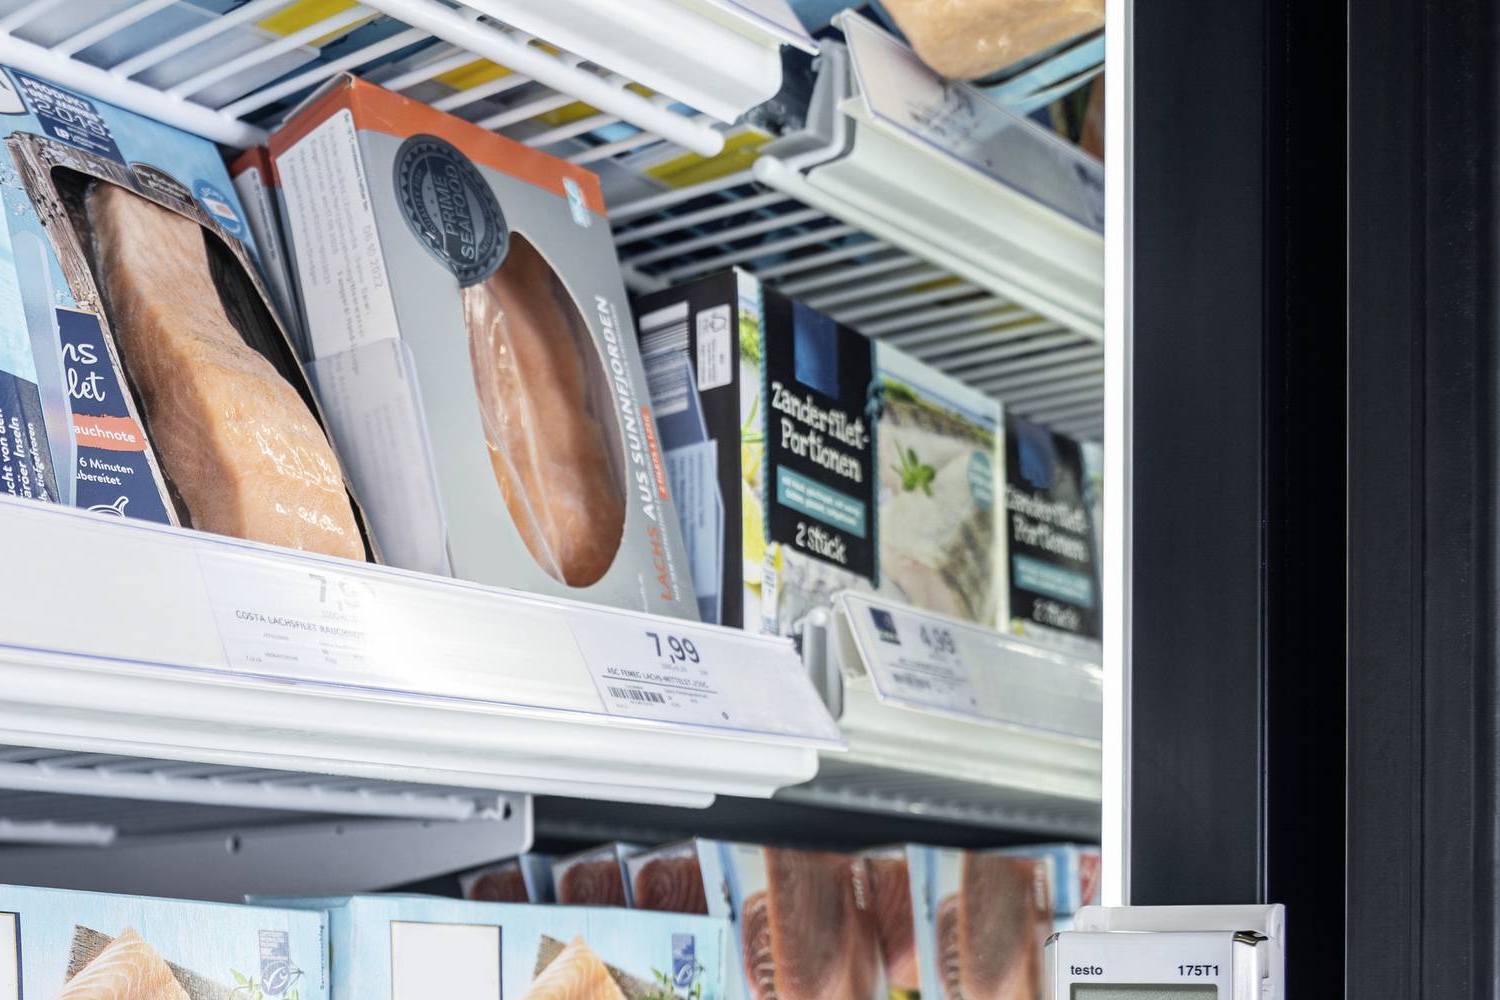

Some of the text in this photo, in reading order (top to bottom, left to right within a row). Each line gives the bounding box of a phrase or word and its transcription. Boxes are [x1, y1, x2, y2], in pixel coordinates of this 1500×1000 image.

[435, 174, 460, 236] PRIME
[446, 164, 475, 261] SEAFOOD
[68, 367, 106, 402] let
[593, 294, 648, 468] SUNNFJORDEN
[73, 423, 137, 444] auchnote
[771, 380, 871, 451] Zanderfilet-
[8, 416, 34, 501] äröer Inseln
[26, 422, 47, 489] tiefgefroren
[79, 456, 135, 475] 6 Minuten
[780, 417, 863, 484] Portionen
[0, 465, 17, 498] ucht
[76, 471, 123, 486] ubereitet
[635, 470, 657, 522] AUS
[795, 521, 807, 548] 2
[646, 526, 673, 602] LACHS
[235, 609, 267, 624] COSTA
[645, 631, 700, 664] 7,99
[1070, 964, 1219, 977] testo 175T1
